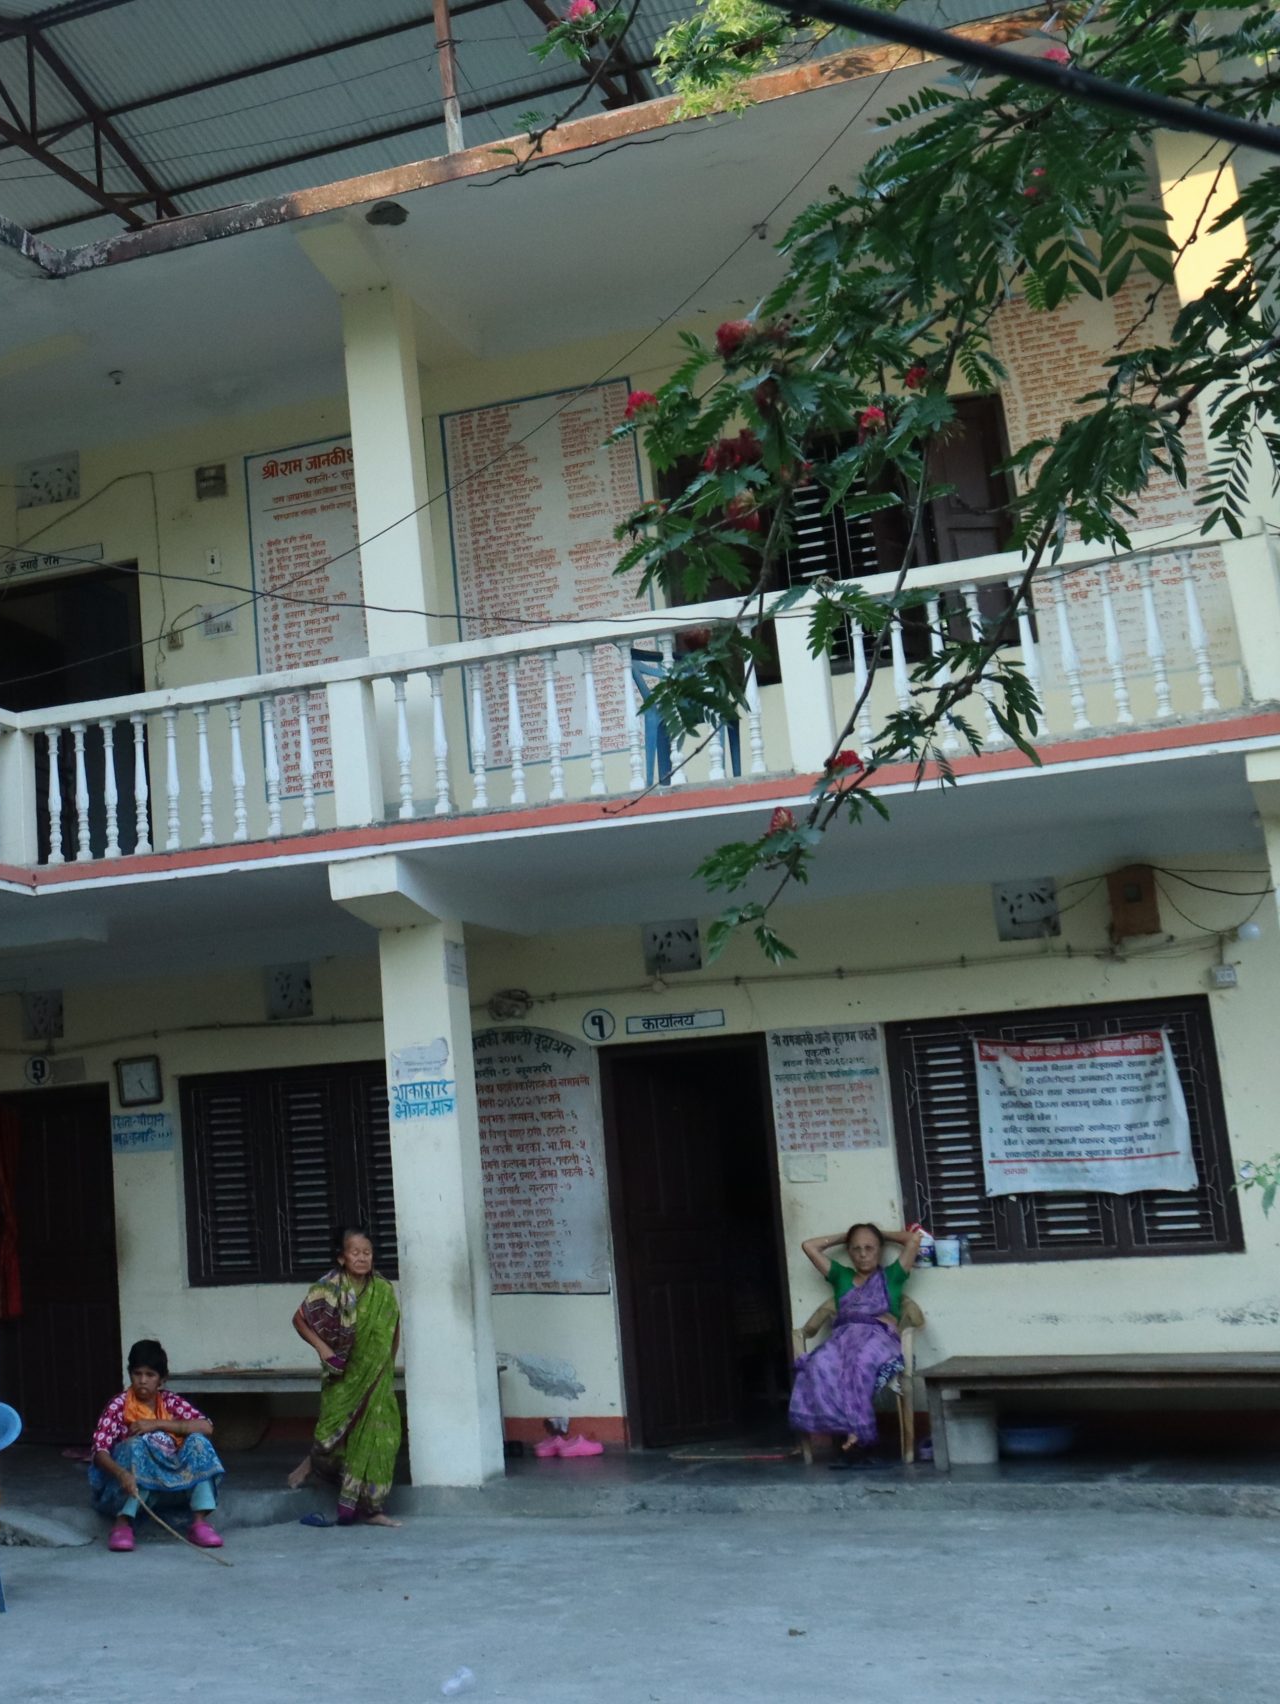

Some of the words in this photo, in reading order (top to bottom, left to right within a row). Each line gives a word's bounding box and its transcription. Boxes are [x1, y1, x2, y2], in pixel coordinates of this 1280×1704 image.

[305, 447, 345, 470] जानकी
[591, 1016, 605, 1039] १
[641, 1014, 695, 1030] कार्यालय
[534, 1033, 576, 1058] वृद्धाश्रम
[395, 1101, 428, 1120] भोजन
[429, 1098, 454, 1116] मात्र
